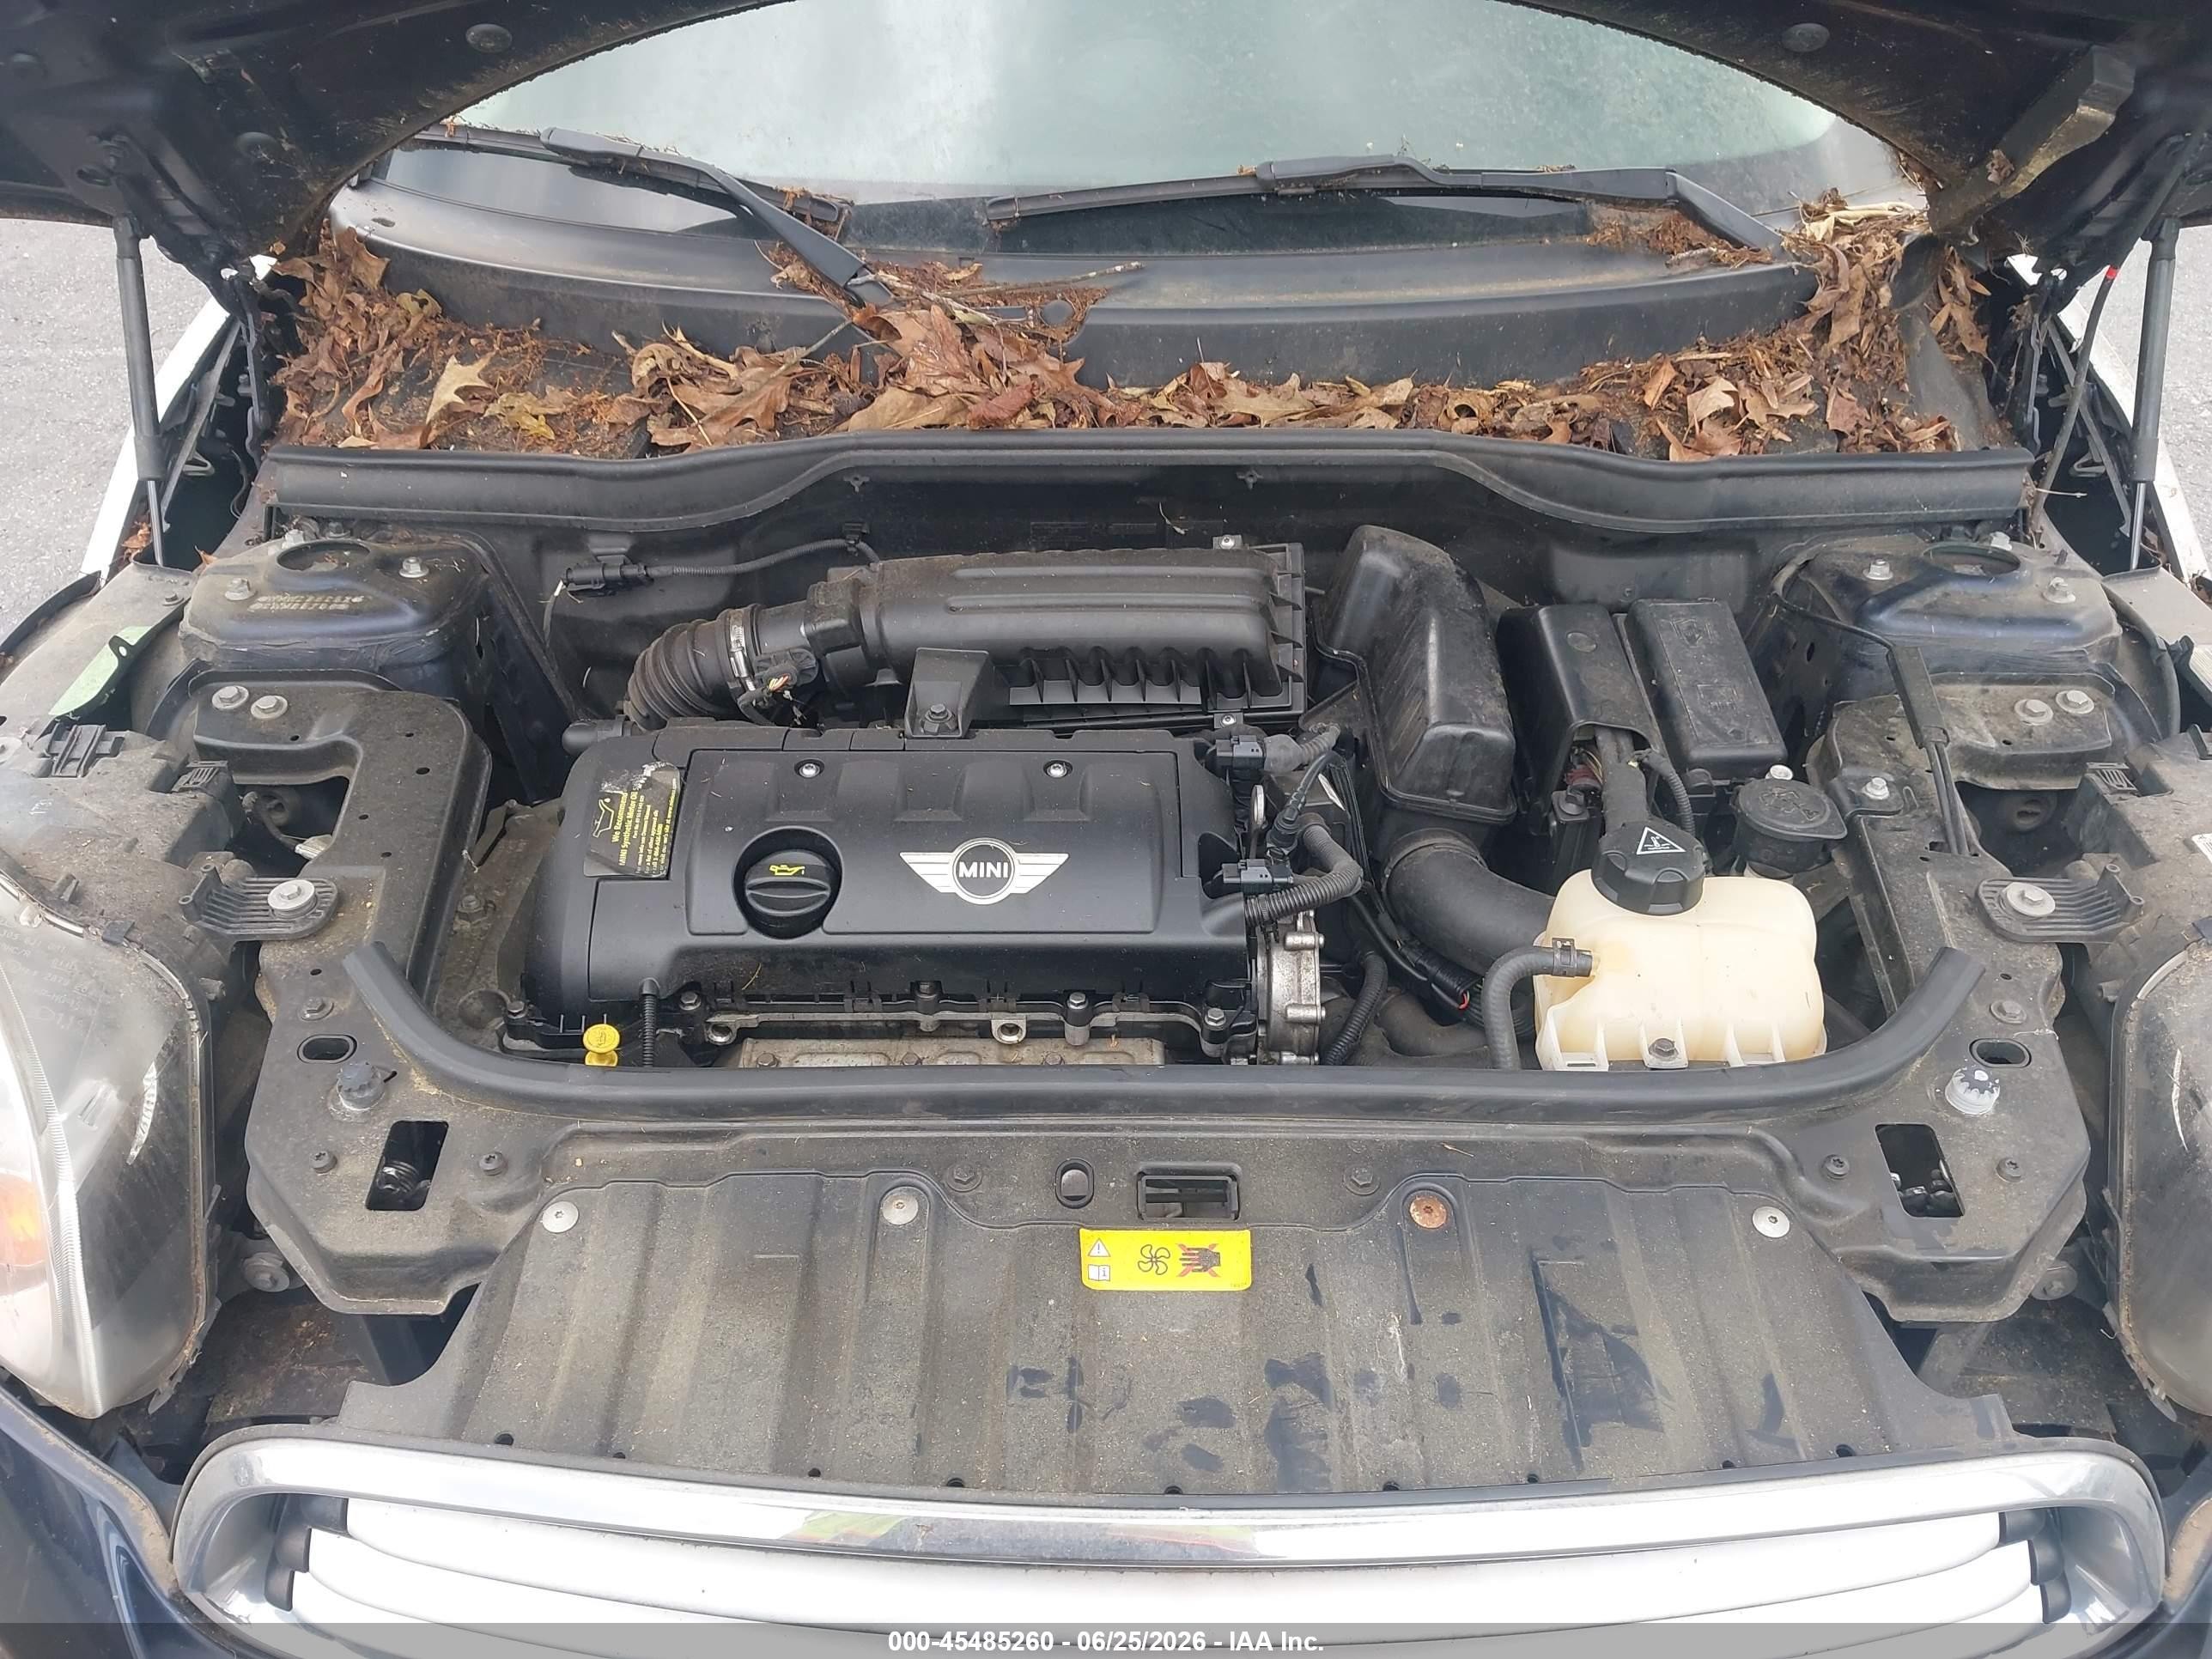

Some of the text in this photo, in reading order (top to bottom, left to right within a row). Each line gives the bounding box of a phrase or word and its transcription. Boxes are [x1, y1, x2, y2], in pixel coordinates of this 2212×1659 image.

[611, 793, 628, 842] We Recommend
[627, 800, 636, 818] Motor
[621, 819, 632, 848] Synthetic
[618, 849, 627, 866] MINI
[959, 861, 1009, 878] MINI
